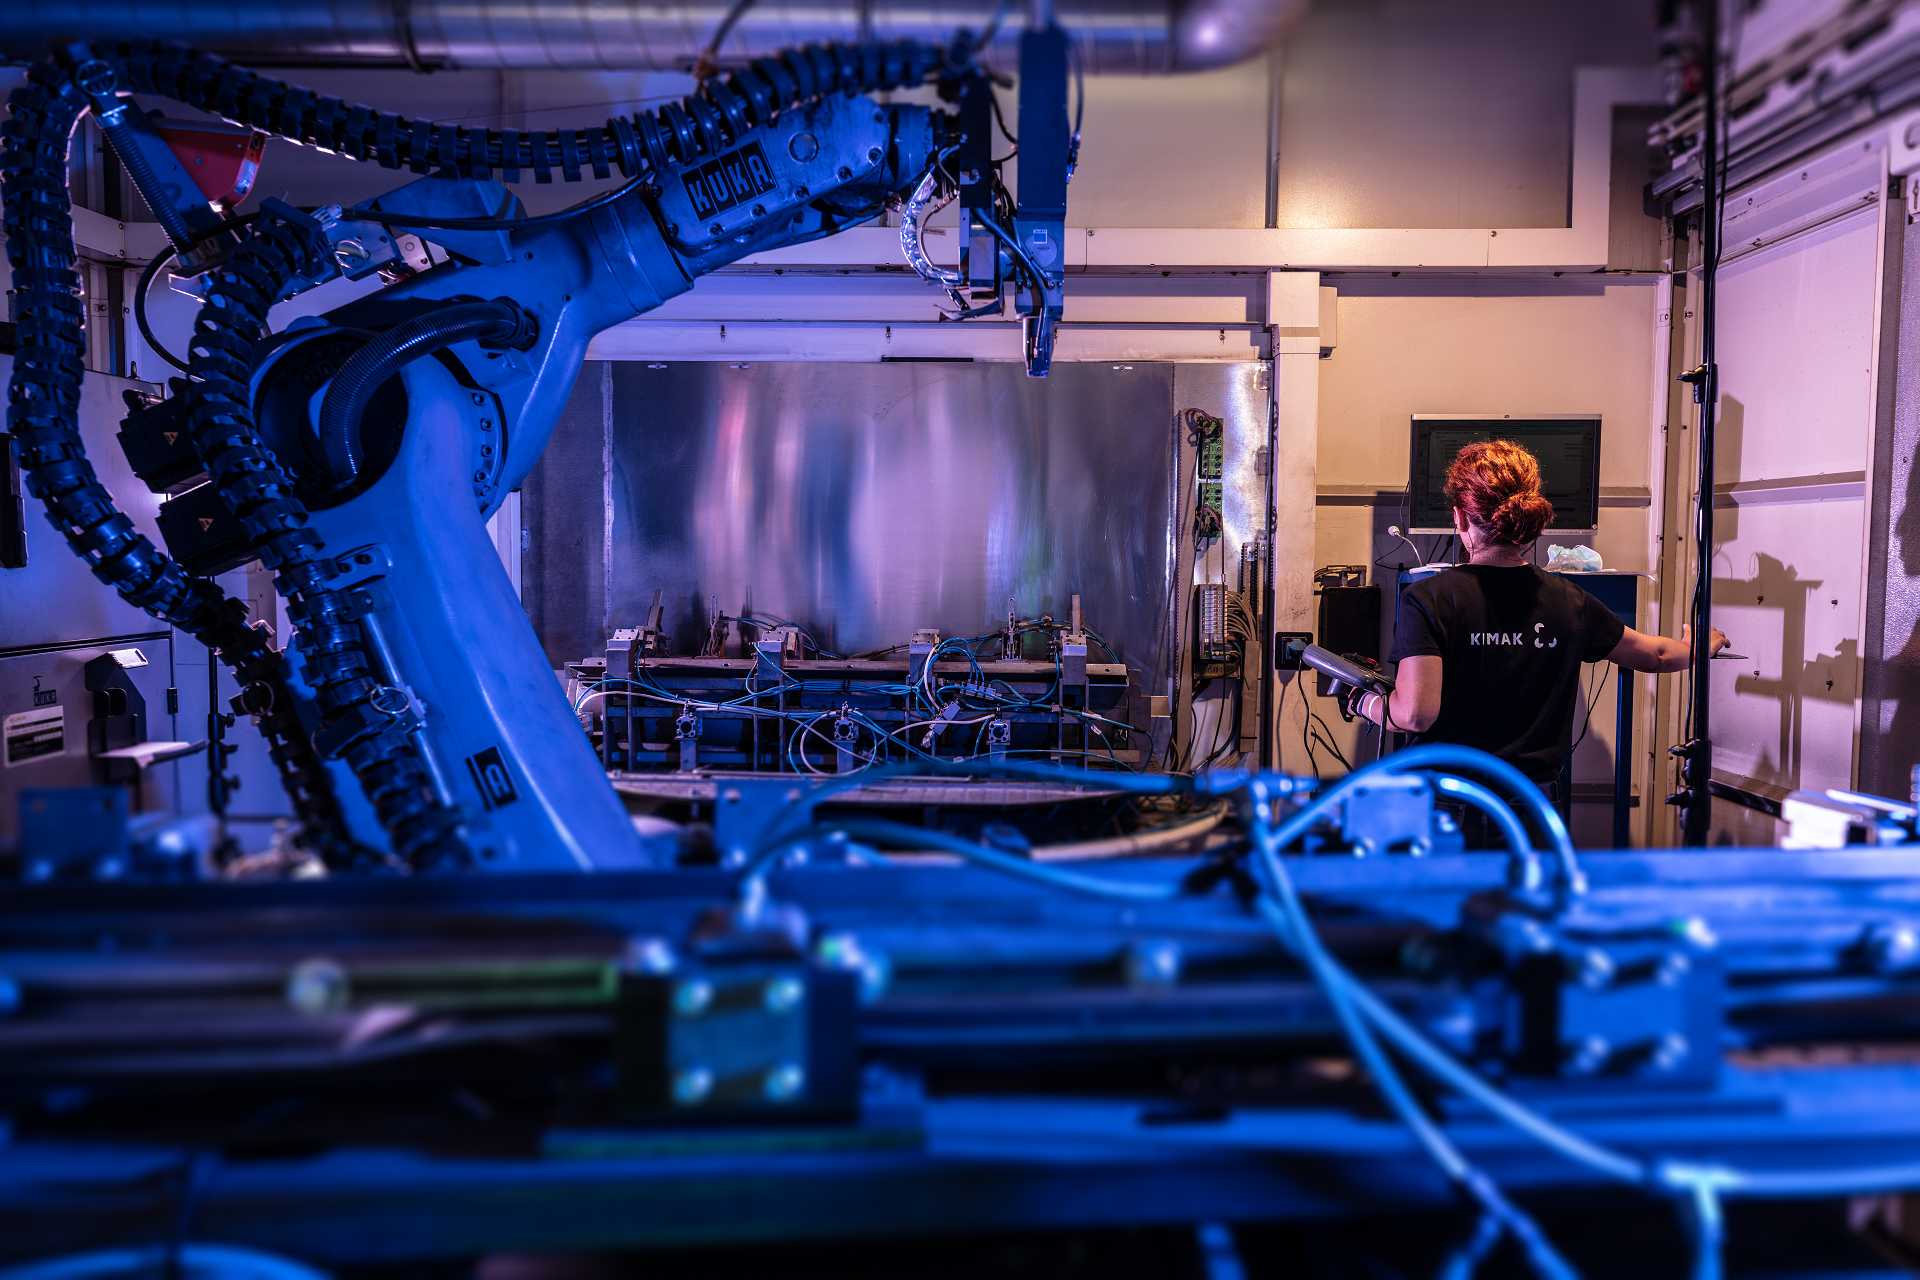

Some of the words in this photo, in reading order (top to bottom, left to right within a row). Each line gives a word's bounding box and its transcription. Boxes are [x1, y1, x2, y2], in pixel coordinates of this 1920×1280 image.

[687, 154, 771, 214] KUKA
[1470, 632, 1524, 646] KIMAK
[34, 691, 56, 705] KUKA
